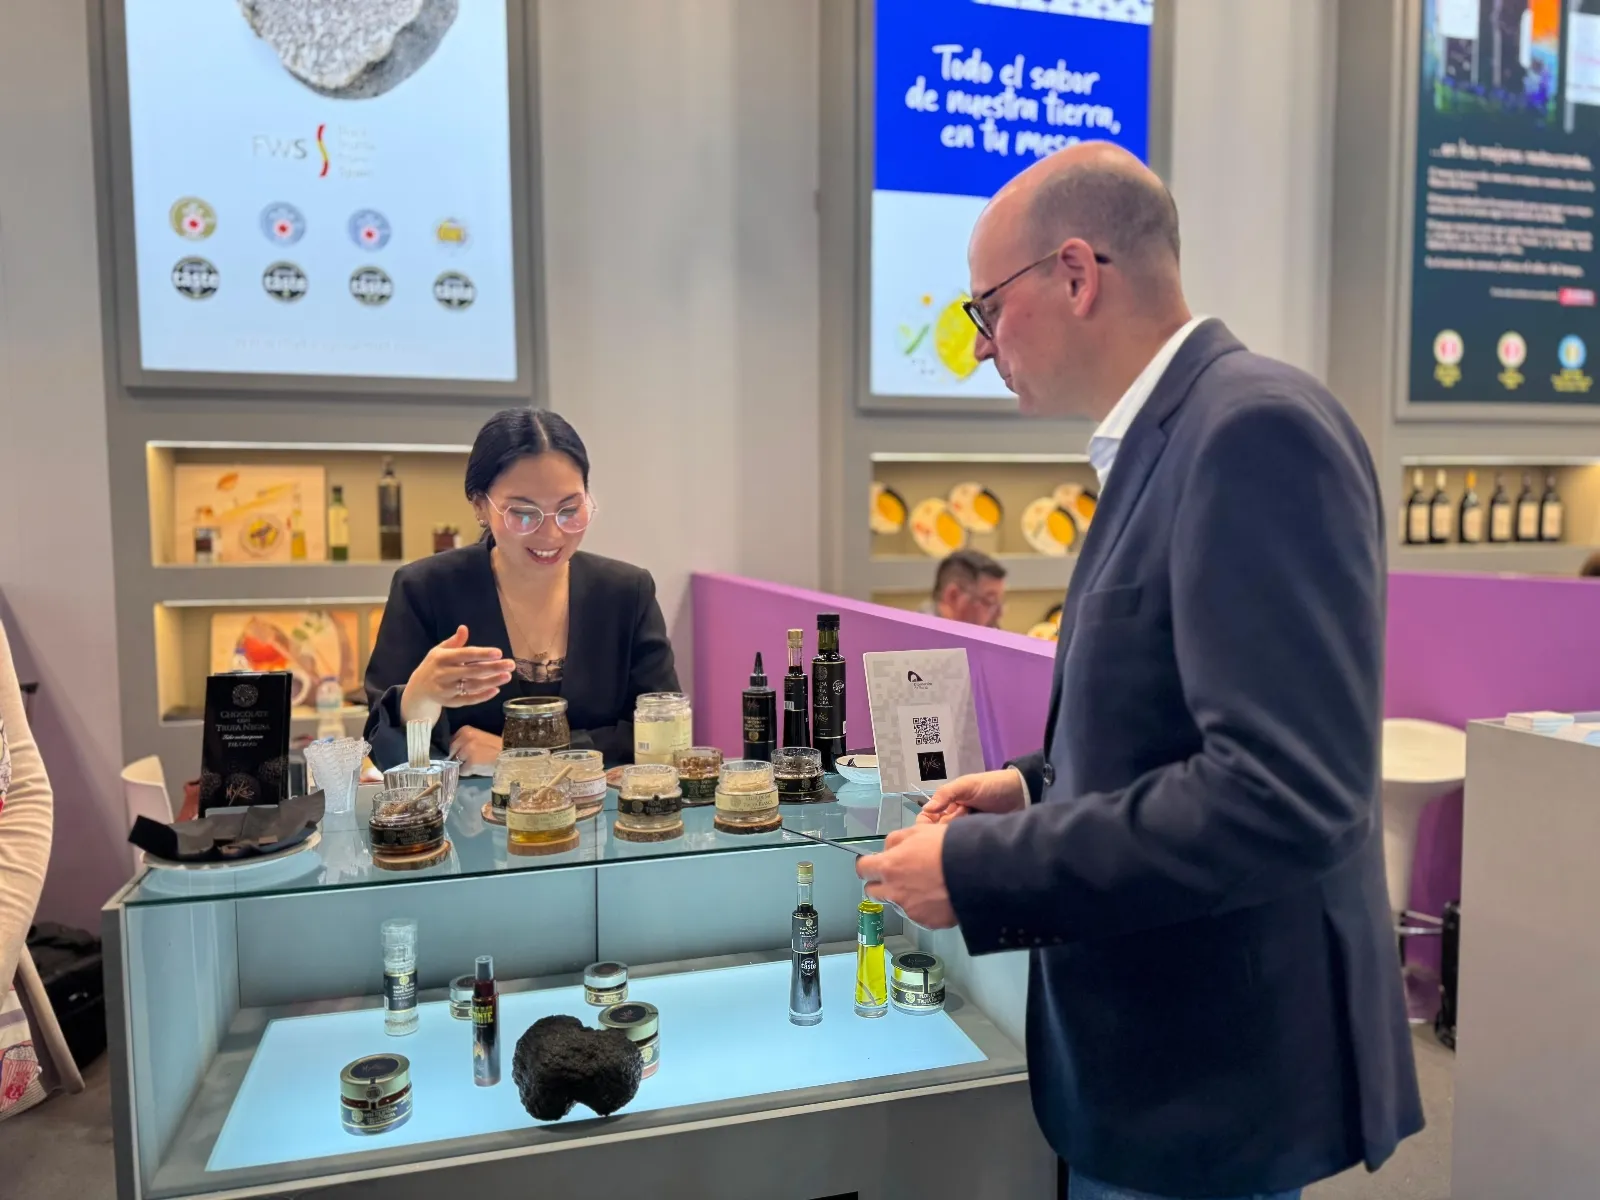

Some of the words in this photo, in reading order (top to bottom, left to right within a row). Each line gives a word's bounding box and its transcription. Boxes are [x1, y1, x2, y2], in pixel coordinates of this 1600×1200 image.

[932, 44, 993, 84] Todo
[999, 54, 1025, 89] el
[1030, 59, 1100, 95] sabor
[905, 75, 939, 112] de
[946, 86, 1038, 122] nuestra
[1042, 90, 1121, 135] tierra,
[252, 135, 307, 160] FWS
[940, 124, 975, 148] en
[979, 117, 1010, 157] tu
